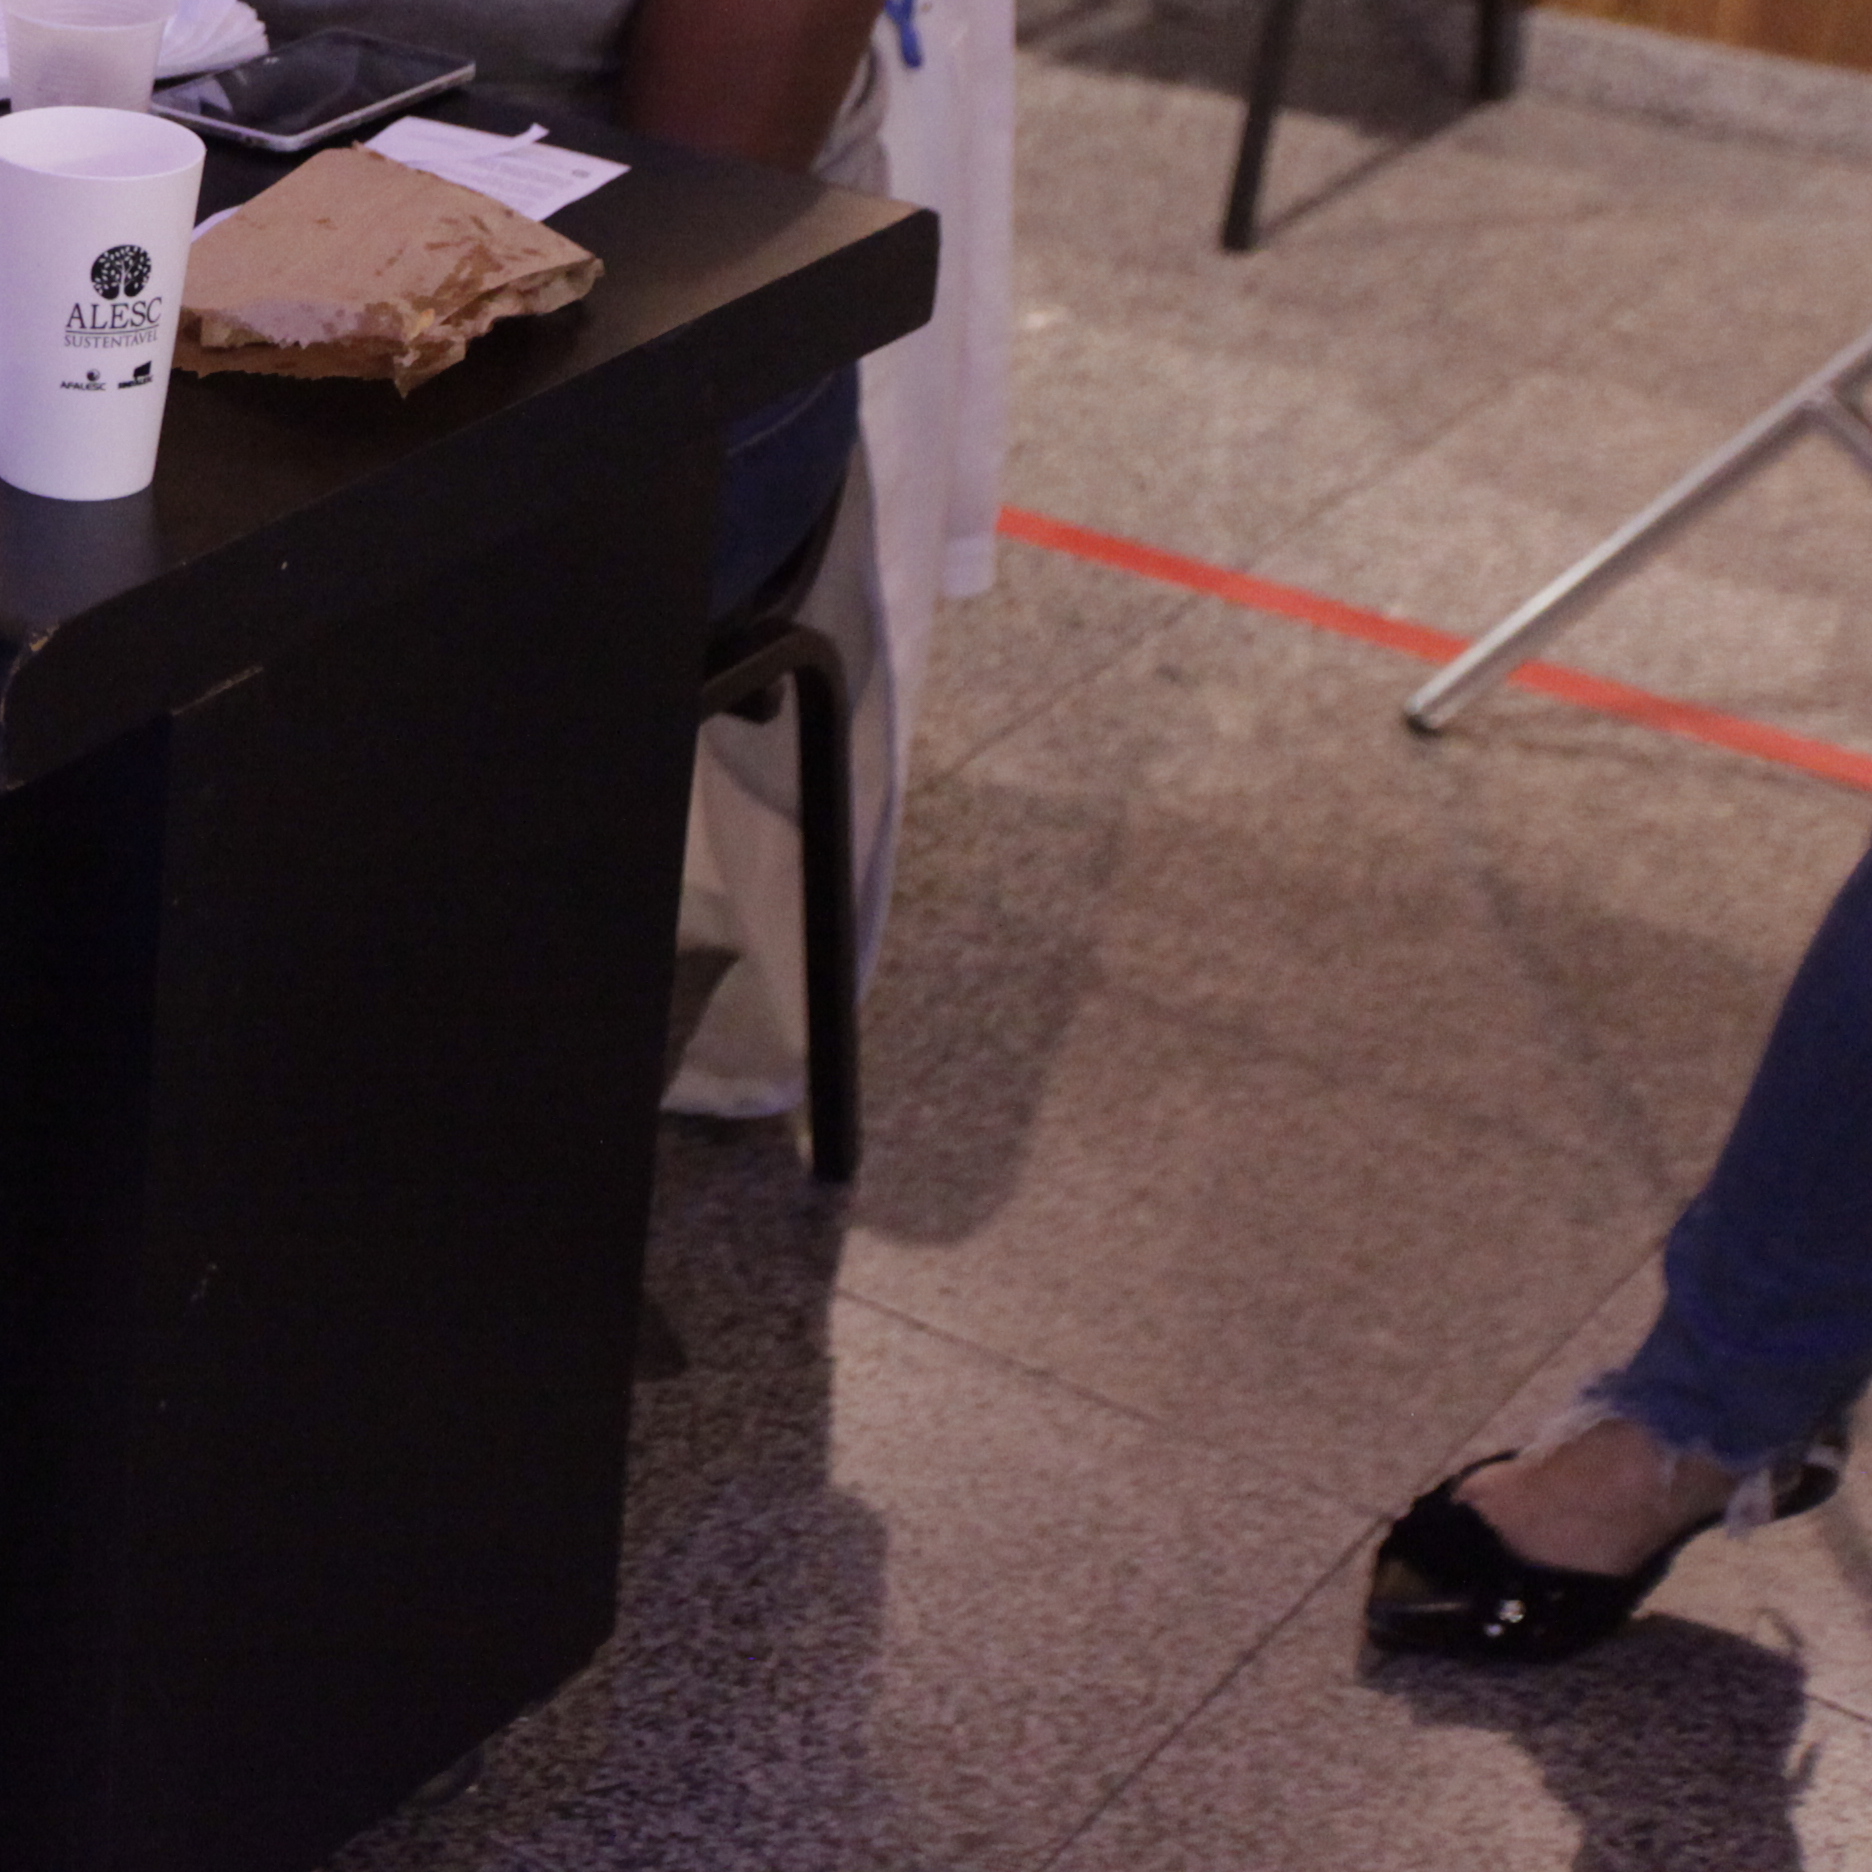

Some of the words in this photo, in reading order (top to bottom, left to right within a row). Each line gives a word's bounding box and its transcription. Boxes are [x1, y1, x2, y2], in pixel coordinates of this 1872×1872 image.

[65, 296, 162, 329] ALESC
[63, 329, 158, 349] SUSTENTÁVEL
[60, 380, 106, 392] AFALESC
